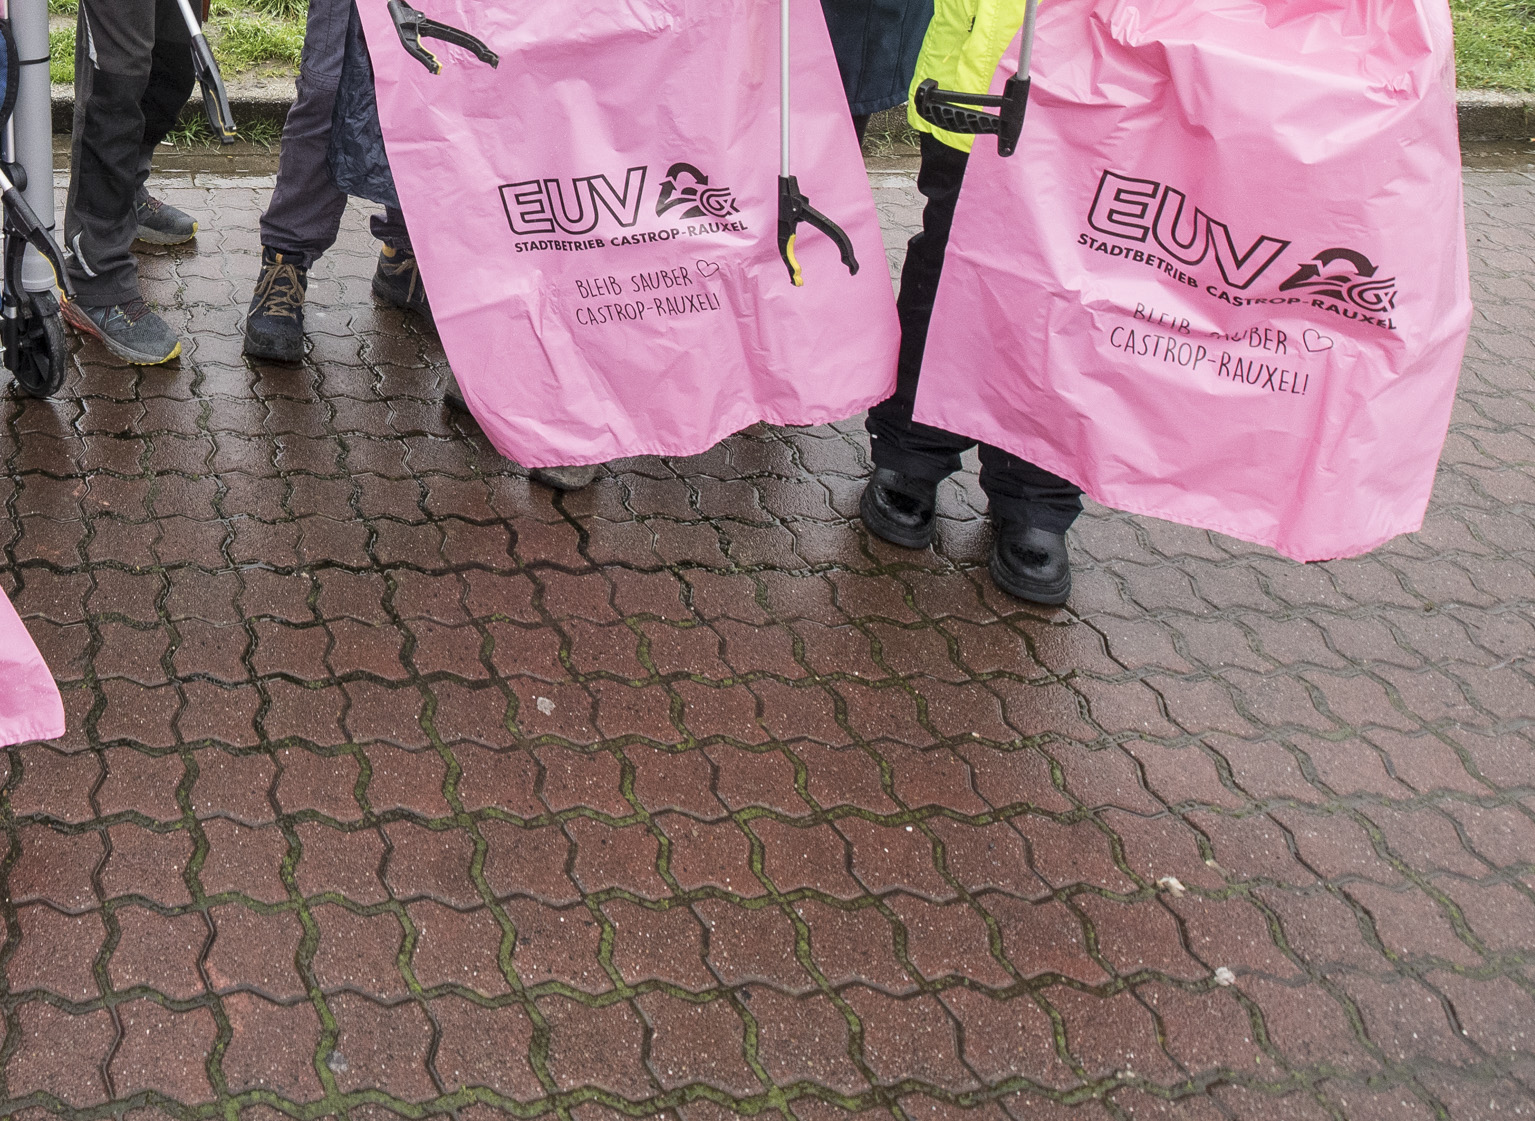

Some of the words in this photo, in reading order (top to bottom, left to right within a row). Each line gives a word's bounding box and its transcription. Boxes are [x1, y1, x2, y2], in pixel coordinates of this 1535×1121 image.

[498, 165, 648, 236] EUV
[1086, 169, 1292, 290] EUV
[514, 237, 606, 253] STADTBETRIEB
[610, 219, 749, 248] CASTROP-RAUXEL
[575, 275, 623, 300] BLEIB
[631, 265, 693, 294] SAUBER
[575, 292, 722, 326] CASTROP-RAUXEL!
[1077, 232, 1199, 288] STADTBETRIEB
[1206, 284, 1397, 331] CASTROP-RAUXEL
[1109, 326, 1310, 396] CASTROP-RAUXEL!
